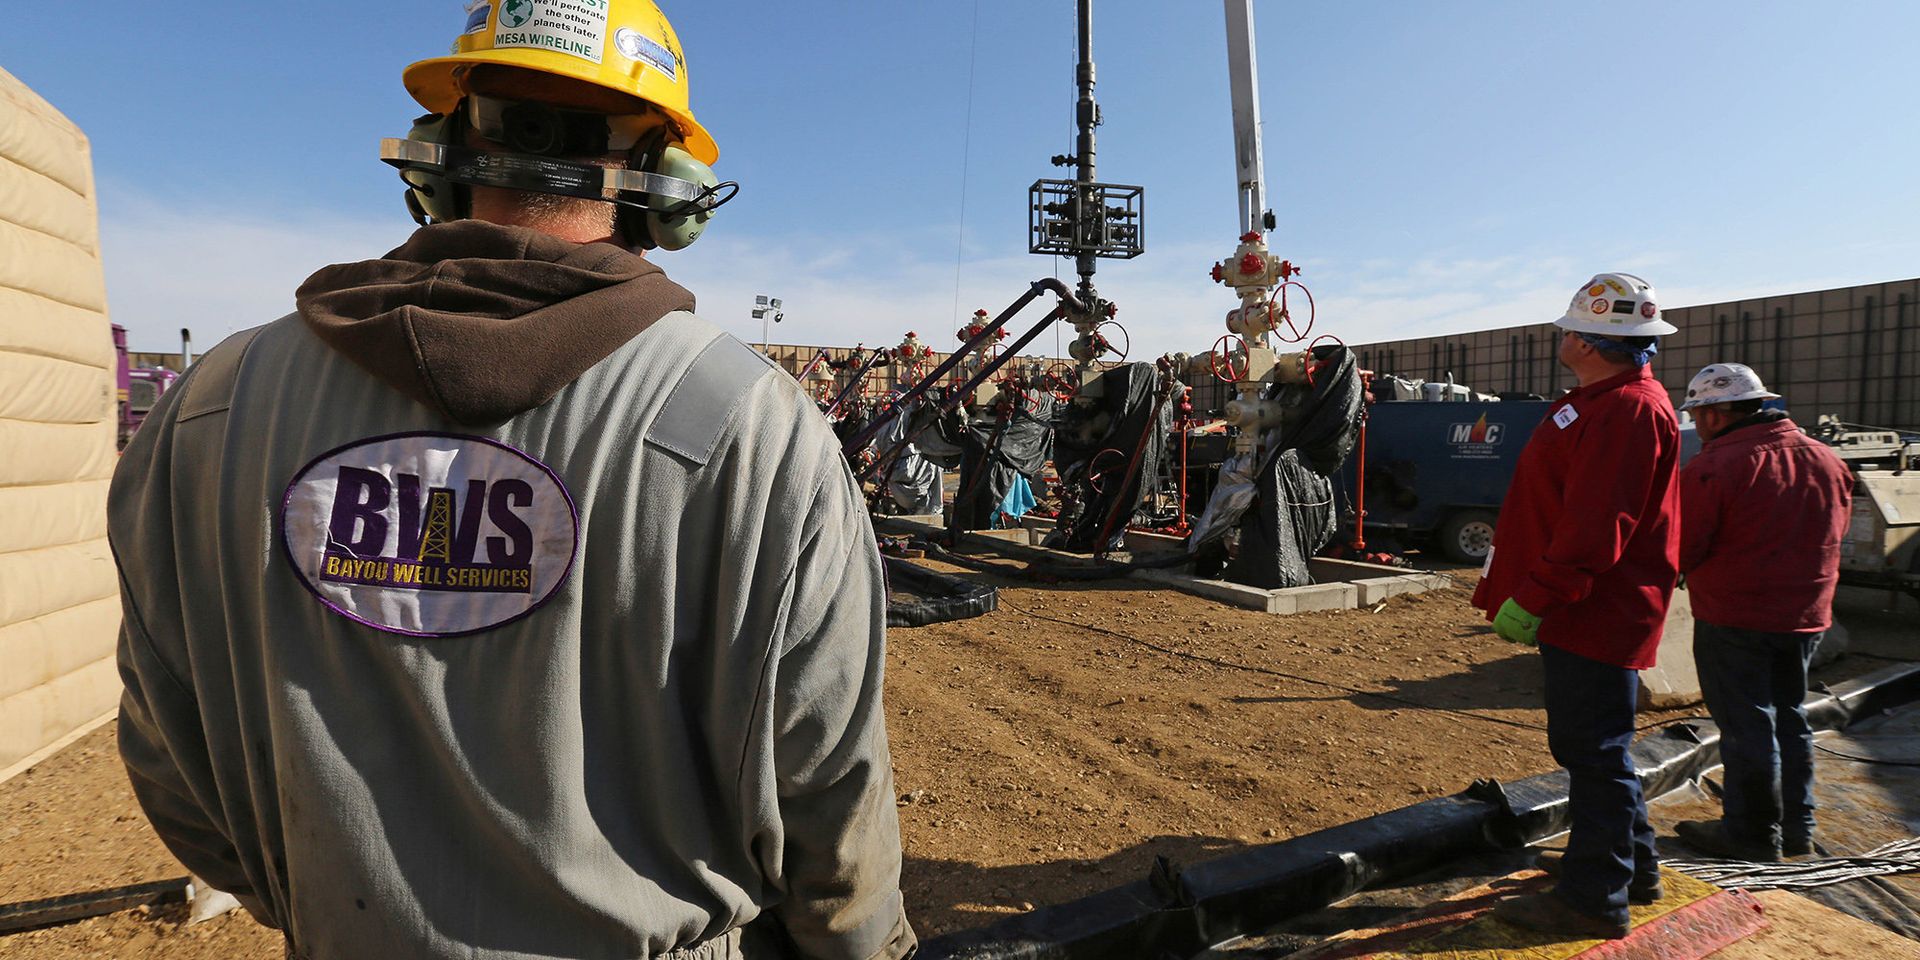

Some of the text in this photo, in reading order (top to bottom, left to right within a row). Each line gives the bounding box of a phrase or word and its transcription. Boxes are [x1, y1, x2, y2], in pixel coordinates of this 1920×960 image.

[545, 9, 591, 26] the other
[560, 2, 606, 21] perforate
[534, 19, 599, 41] planets later.
[495, 33, 527, 45] MESA
[529, 33, 592, 57] WIRELINE
[326, 465, 534, 565] BWS
[326, 556, 530, 589] BAYOU WELL SERVICES
